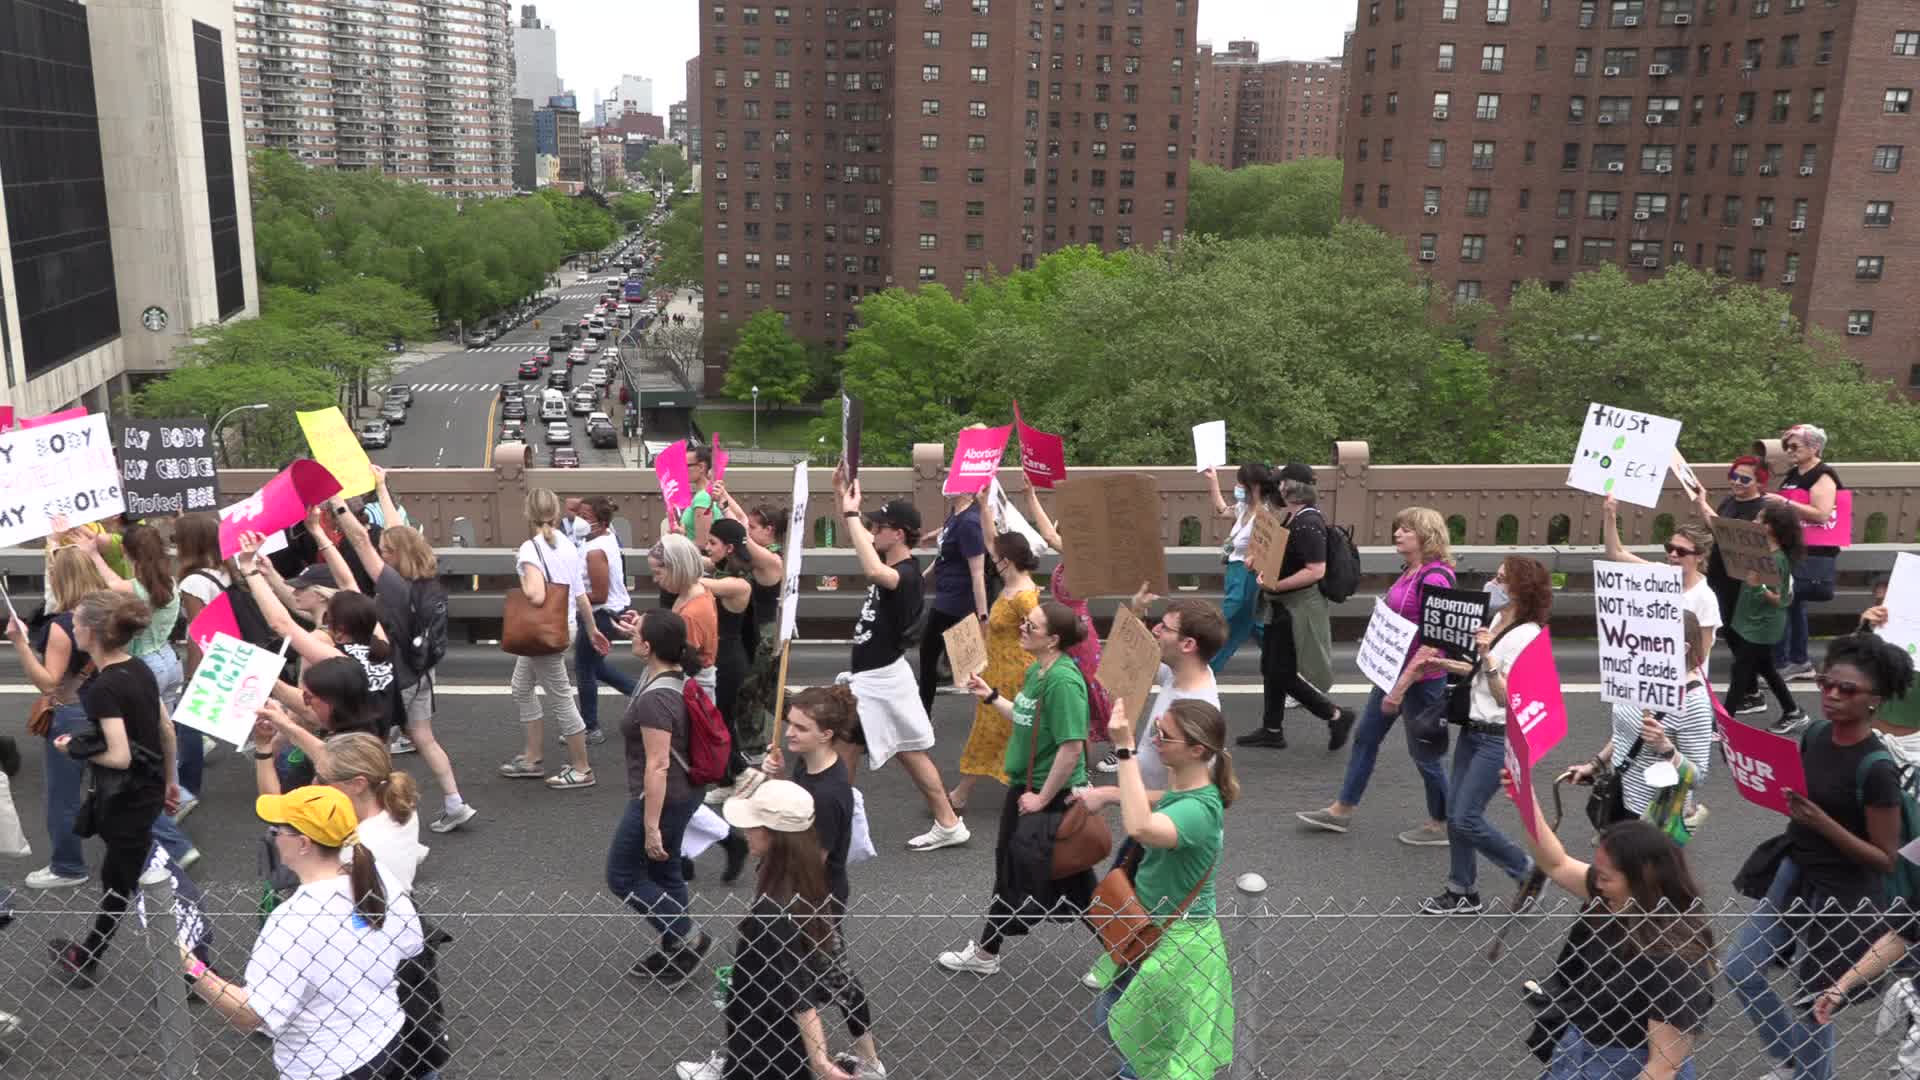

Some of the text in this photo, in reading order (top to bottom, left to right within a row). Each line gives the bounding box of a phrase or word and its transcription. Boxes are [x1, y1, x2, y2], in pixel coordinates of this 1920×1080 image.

[35, 427, 92, 457] BODY
[124, 427, 206, 451] MY BODY
[124, 459, 149, 481] MY
[155, 457, 215, 479] CHOICE
[1023, 454, 1051, 472] Care.
[127, 490, 183, 513] Protect
[1596, 570, 1681, 594] NOT the church
[1425, 595, 1484, 617] ABORTION
[1598, 595, 1682, 623] NOT the state,
[1423, 608, 1482, 633] IS OUR
[1423, 623, 1477, 651] RIGHT
[1600, 617, 1676, 658] Women
[1602, 656, 1678, 681] must decide
[1603, 676, 1684, 710] their FATE!
